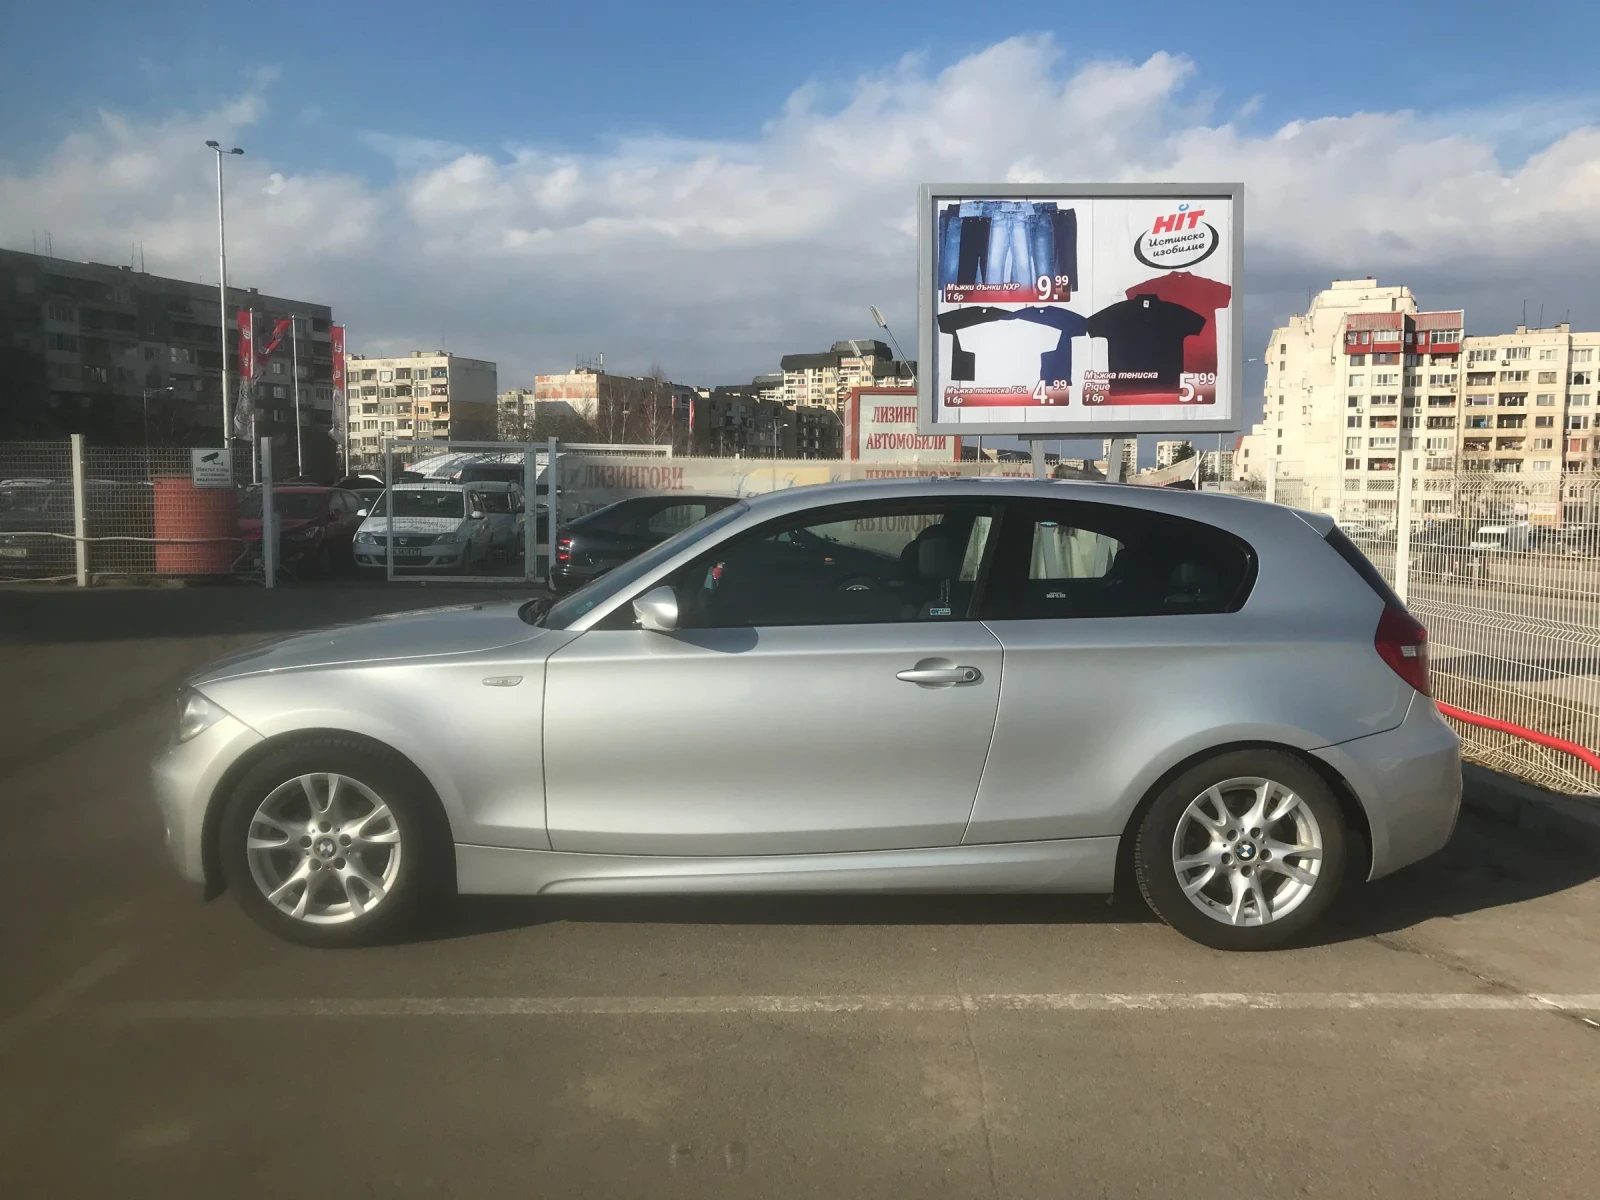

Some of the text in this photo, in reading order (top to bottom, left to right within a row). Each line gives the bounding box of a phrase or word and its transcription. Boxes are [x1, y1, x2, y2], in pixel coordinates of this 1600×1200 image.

[1152, 205, 1206, 235] HIT
[1148, 232, 1205, 248] Истинско
[1152, 242, 1205, 257] изобилие
[946, 283, 1020, 291] Мъжки дънки NXP
[953, 293, 964, 301] бр
[1084, 370, 1159, 380] Мъжка тениска
[946, 386, 973, 394] Мъжка
[1011, 385, 1028, 394] FOL
[1084, 382, 1111, 391] Pique
[946, 395, 963, 405] 1 бр
[1084, 393, 1104, 403] 1 бр
[865, 432, 947, 450] АВТОМОБИЛИ
[583, 465, 685, 490] ЛИЗИНГОВИ
